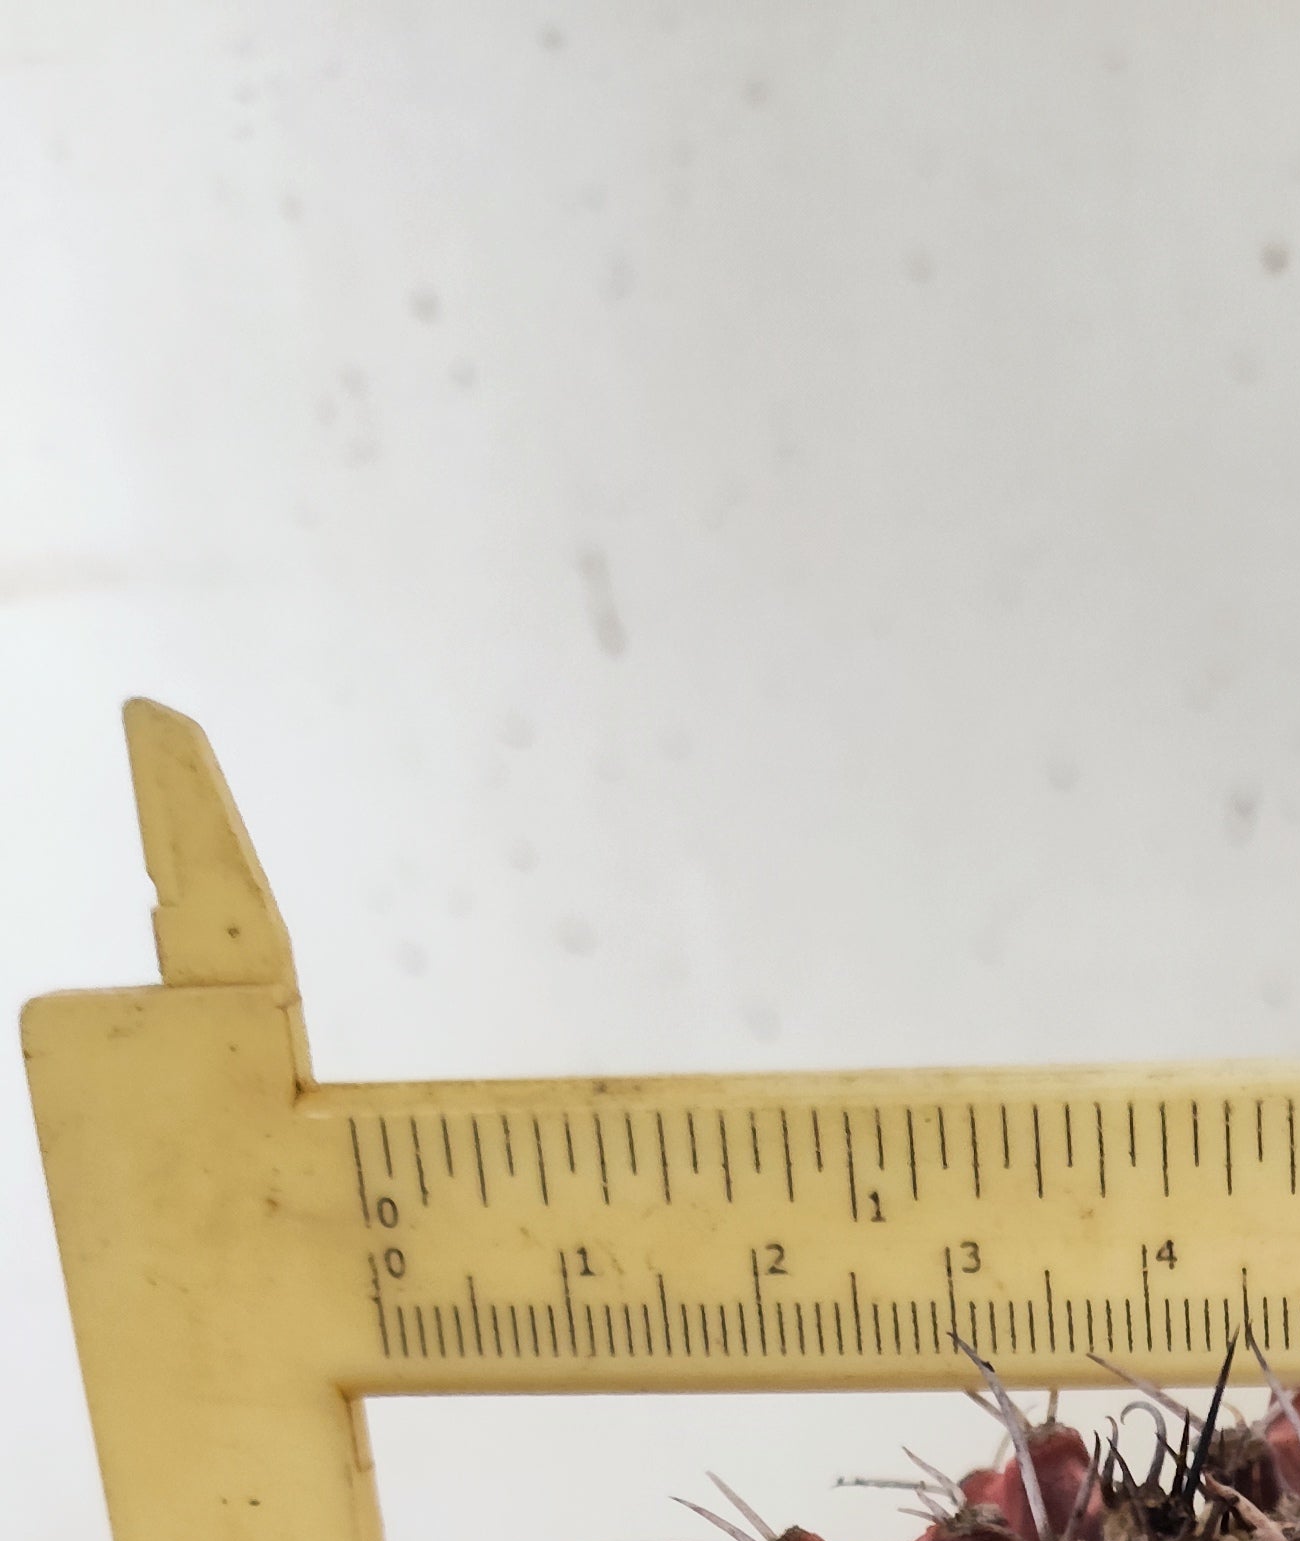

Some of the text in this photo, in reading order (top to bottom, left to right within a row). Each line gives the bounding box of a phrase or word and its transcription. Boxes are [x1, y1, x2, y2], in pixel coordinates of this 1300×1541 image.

[376, 1196, 399, 1228] 0
[869, 1191, 886, 1223] 1
[384, 1247, 405, 1278] 0
[577, 1246, 596, 1277] 1
[765, 1243, 788, 1276] 2
[960, 1241, 982, 1274] 3
[1155, 1240, 1178, 1270] 4
